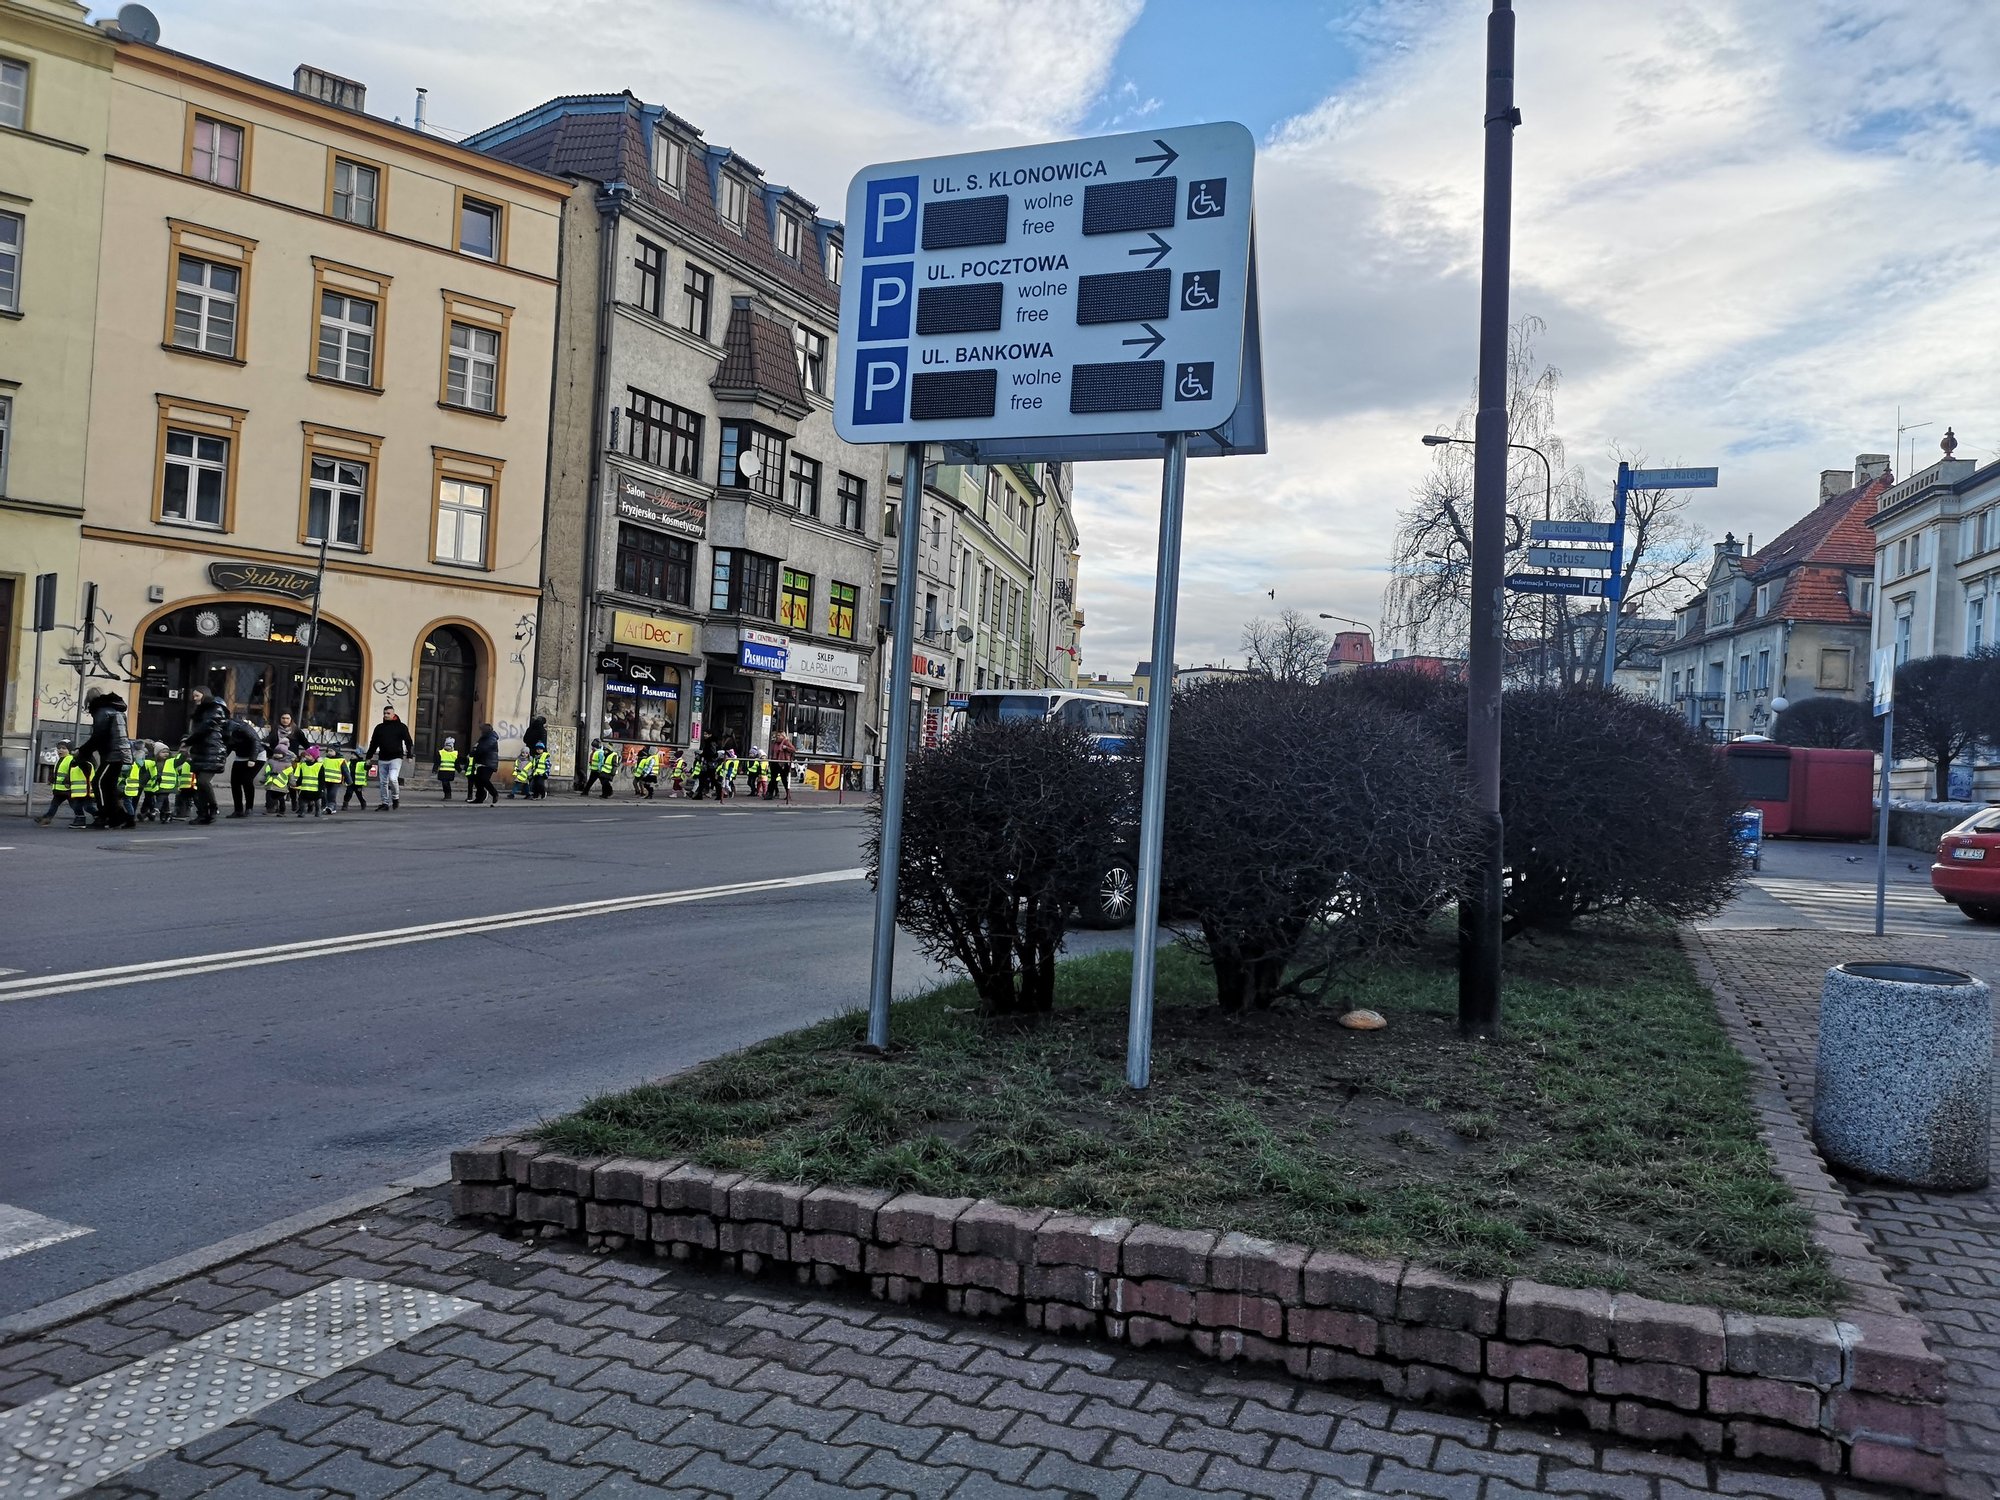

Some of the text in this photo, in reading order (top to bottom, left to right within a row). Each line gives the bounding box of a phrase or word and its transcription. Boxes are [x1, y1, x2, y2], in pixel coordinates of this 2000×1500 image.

[933, 160, 1107, 194] UL. S. KLONOWICA
[1024, 192, 1073, 210] wolne
[876, 191, 911, 243] P
[1022, 219, 1055, 235] free
[927, 254, 1069, 280] UL. POCZTOWA
[1018, 281, 1067, 298] wolne
[870, 277, 906, 326] P
[1016, 307, 1049, 322] free
[922, 342, 1054, 364] UL. BANKOWA
[1012, 369, 1061, 385] wolne
[865, 361, 900, 410] P
[1010, 395, 1043, 410] free
[1674, 470, 1706, 481] Matejki
[626, 483, 646, 499] Salon
[622, 501, 656, 520] Fryzjersko
[661, 513, 704, 536] Kosmetyczny
[1542, 524, 1553, 532] ul.
[1549, 551, 1586, 565] Ratusz
[217, 567, 315, 591] Jubiler
[1512, 579, 1580, 589] Informacja Turystyczna
[817, 652, 834, 663] SKLEP
[832, 664, 849, 677] KOTA
